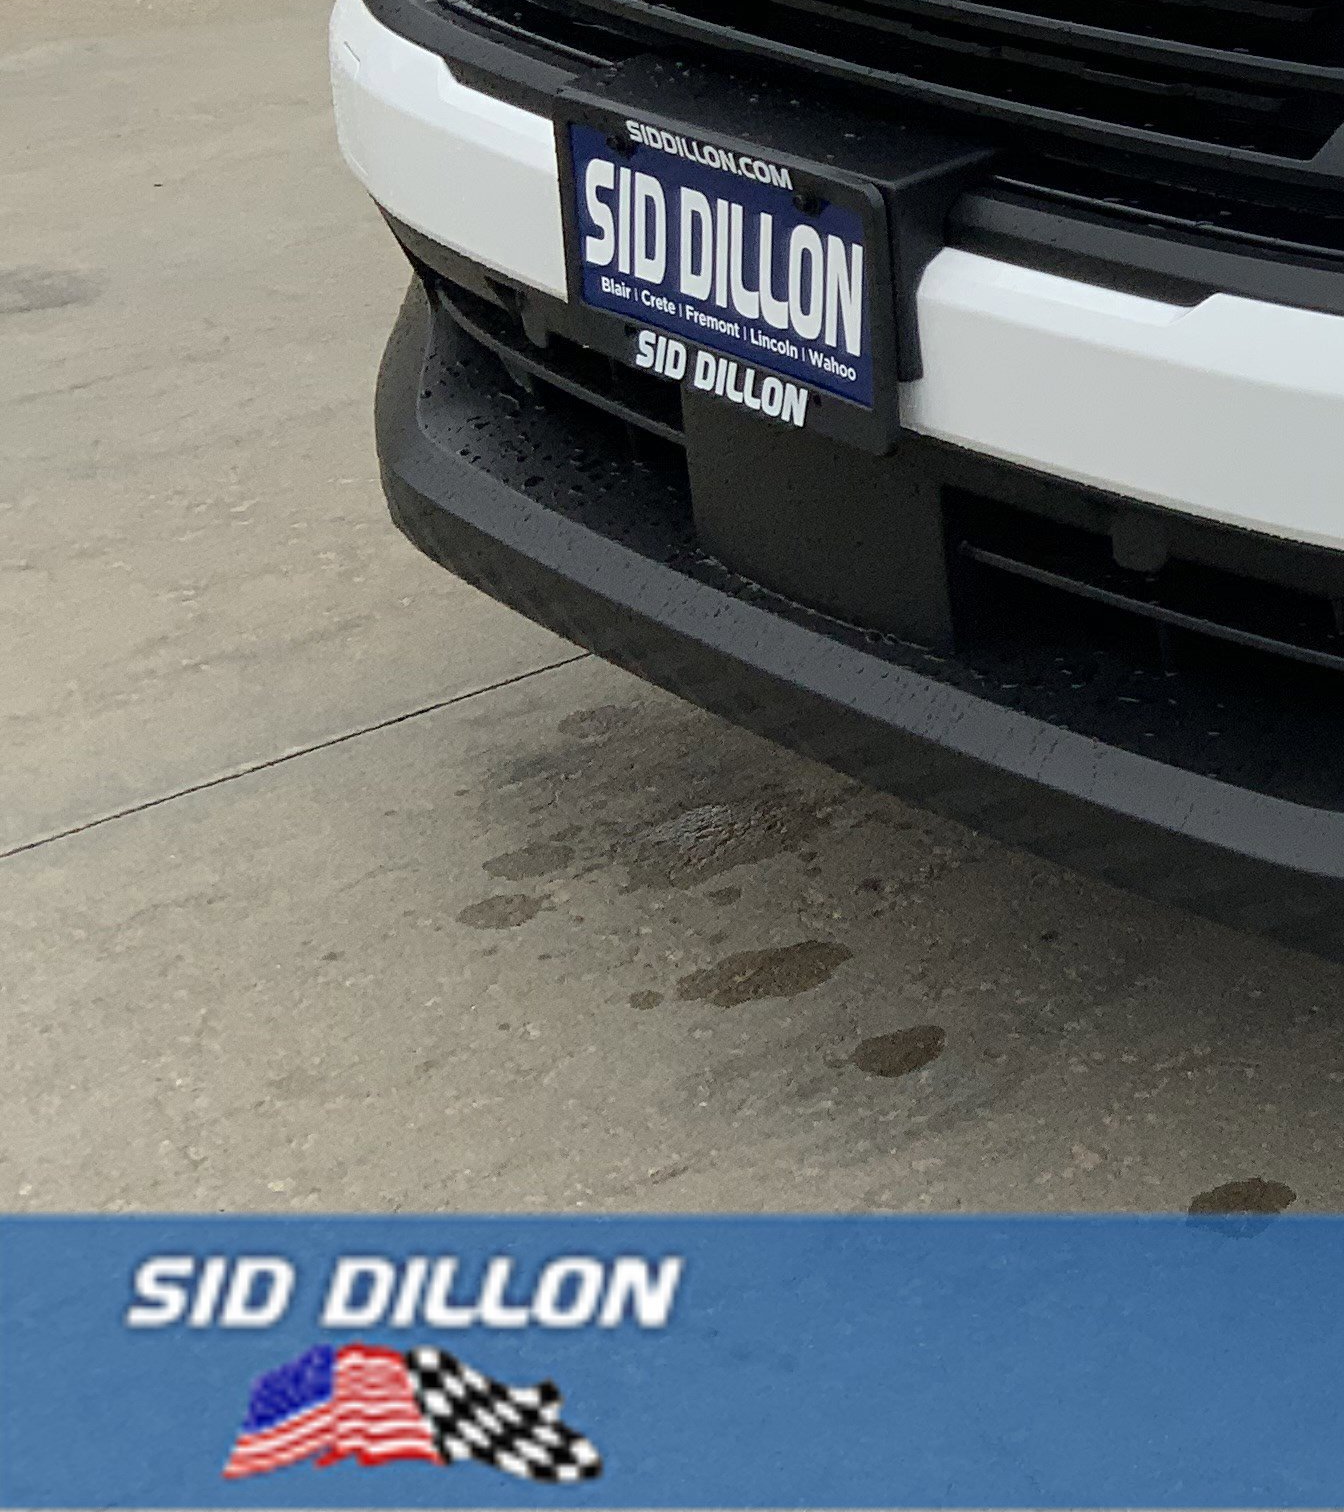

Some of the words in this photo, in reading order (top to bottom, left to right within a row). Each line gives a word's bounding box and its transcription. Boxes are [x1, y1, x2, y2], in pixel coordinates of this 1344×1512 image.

[625, 119, 793, 191] SIDDILLON.COM
[584, 157, 667, 286] SID
[680, 185, 864, 358] DILLON
[601, 276, 631, 301] Blair
[640, 288, 676, 316] Crete
[685, 305, 740, 339] Fremont
[750, 327, 798, 360] Lincoln
[808, 349, 857, 382] Wahoo
[635, 330, 686, 381] SID
[694, 355, 809, 428] DILLON
